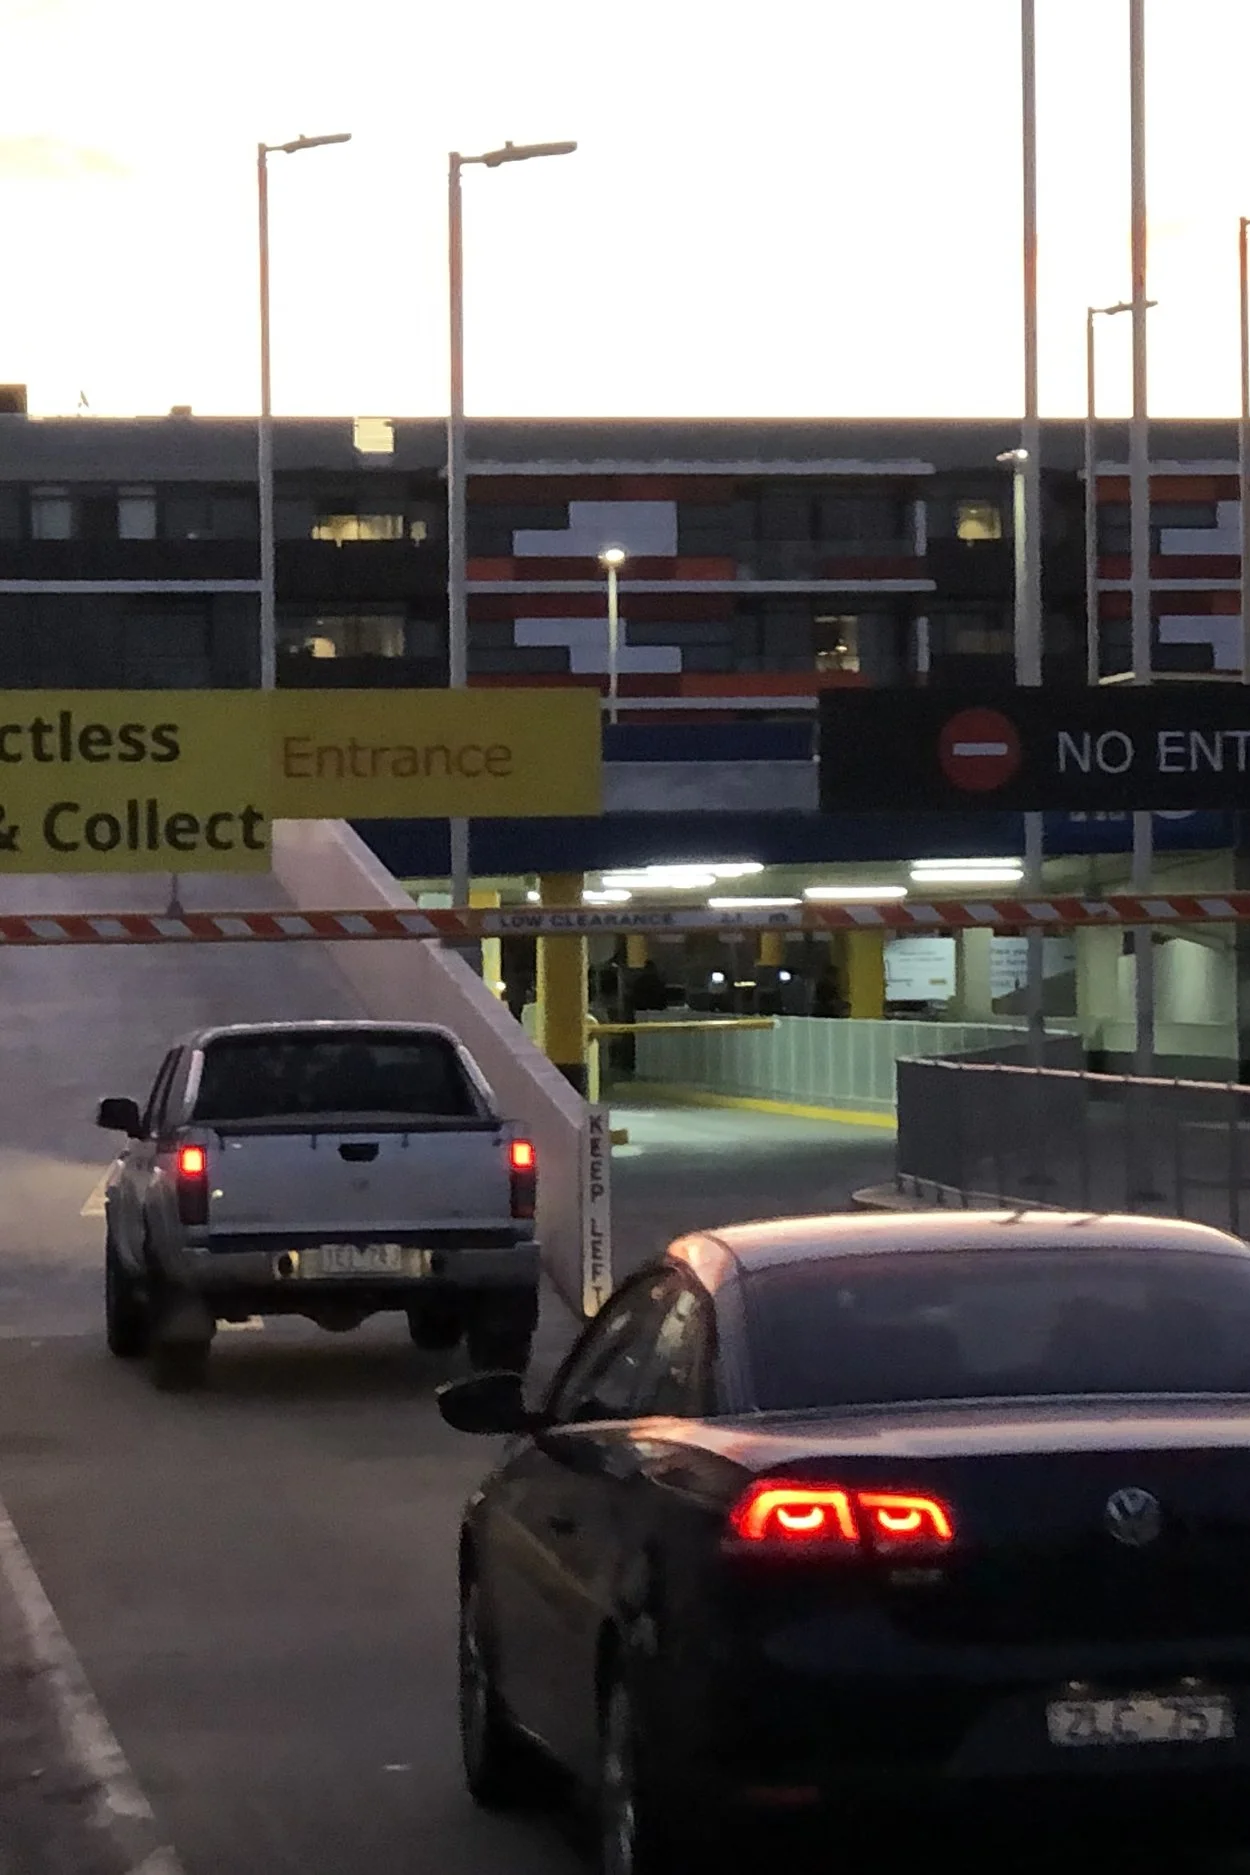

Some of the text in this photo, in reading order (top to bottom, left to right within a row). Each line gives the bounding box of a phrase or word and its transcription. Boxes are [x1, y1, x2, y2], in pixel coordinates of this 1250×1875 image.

[281, 734, 514, 779] Entrance
[1056, 729, 1134, 774] NO
[43, 798, 265, 852] Collect
[499, 914, 543, 929] LOW
[549, 912, 674, 928] CLEARANCE
[588, 1113, 605, 1304] KEEP LEFT
